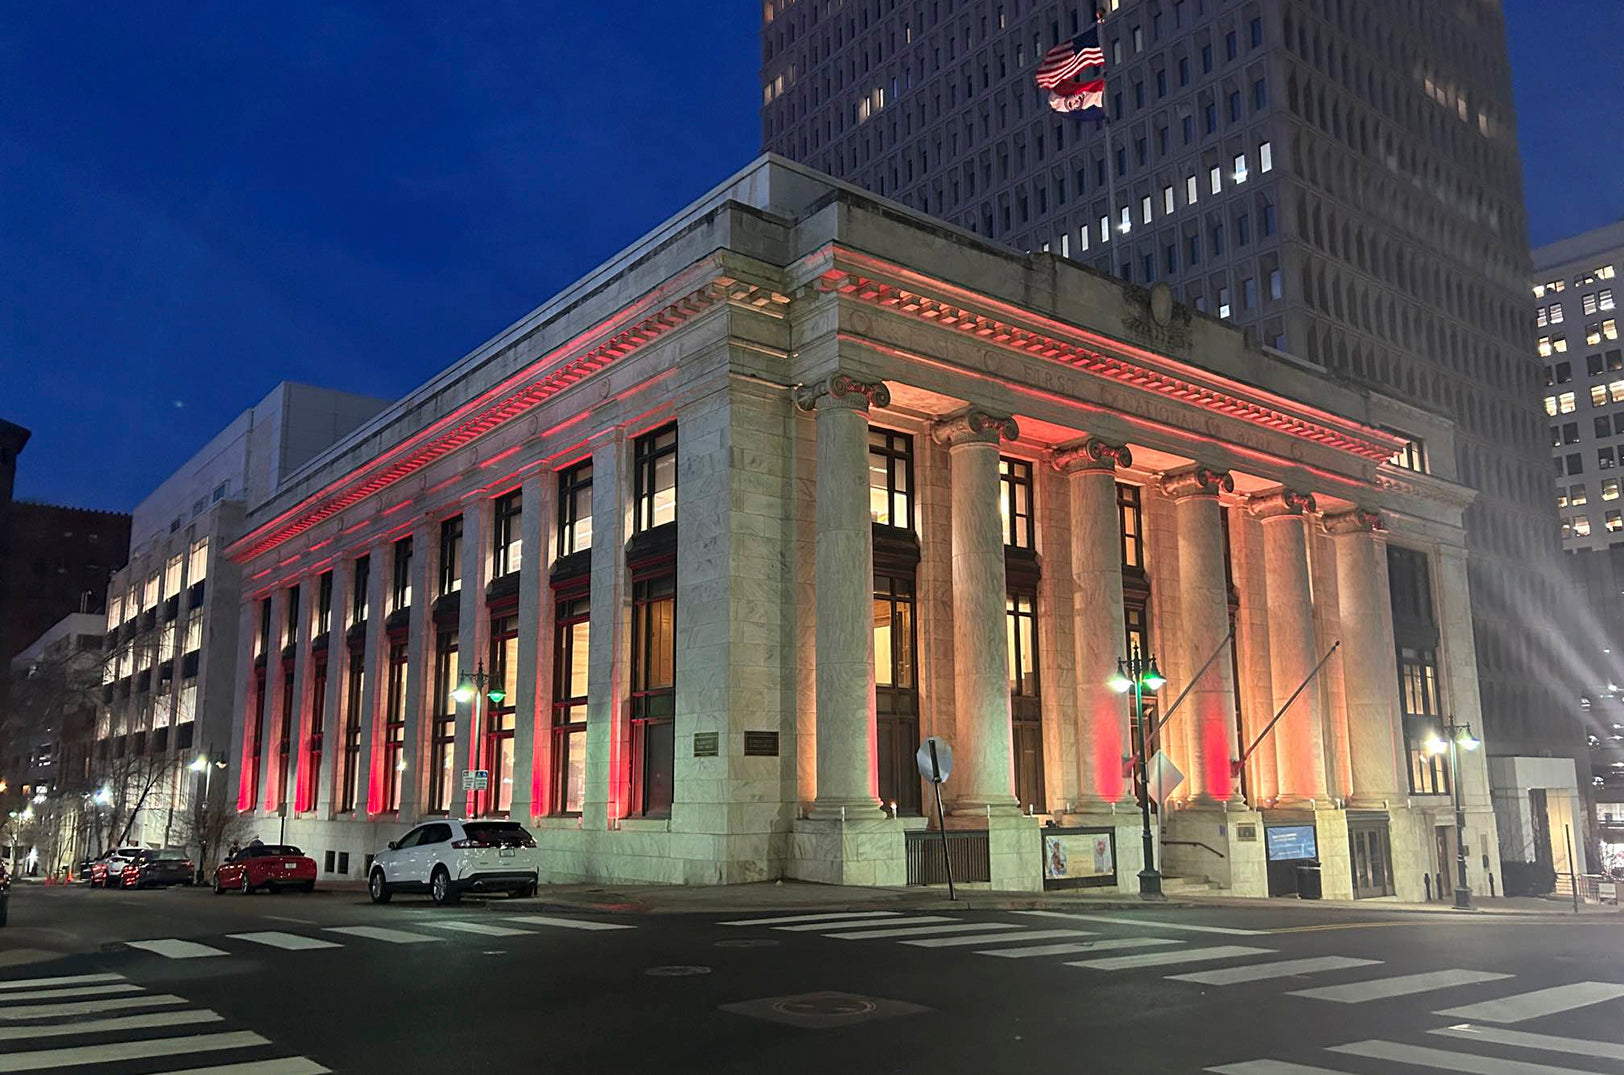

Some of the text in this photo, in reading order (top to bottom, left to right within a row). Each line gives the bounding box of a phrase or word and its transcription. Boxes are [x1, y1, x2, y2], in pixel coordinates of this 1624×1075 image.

[1023, 365, 1273, 450] FIRST NATIONAL BANK
